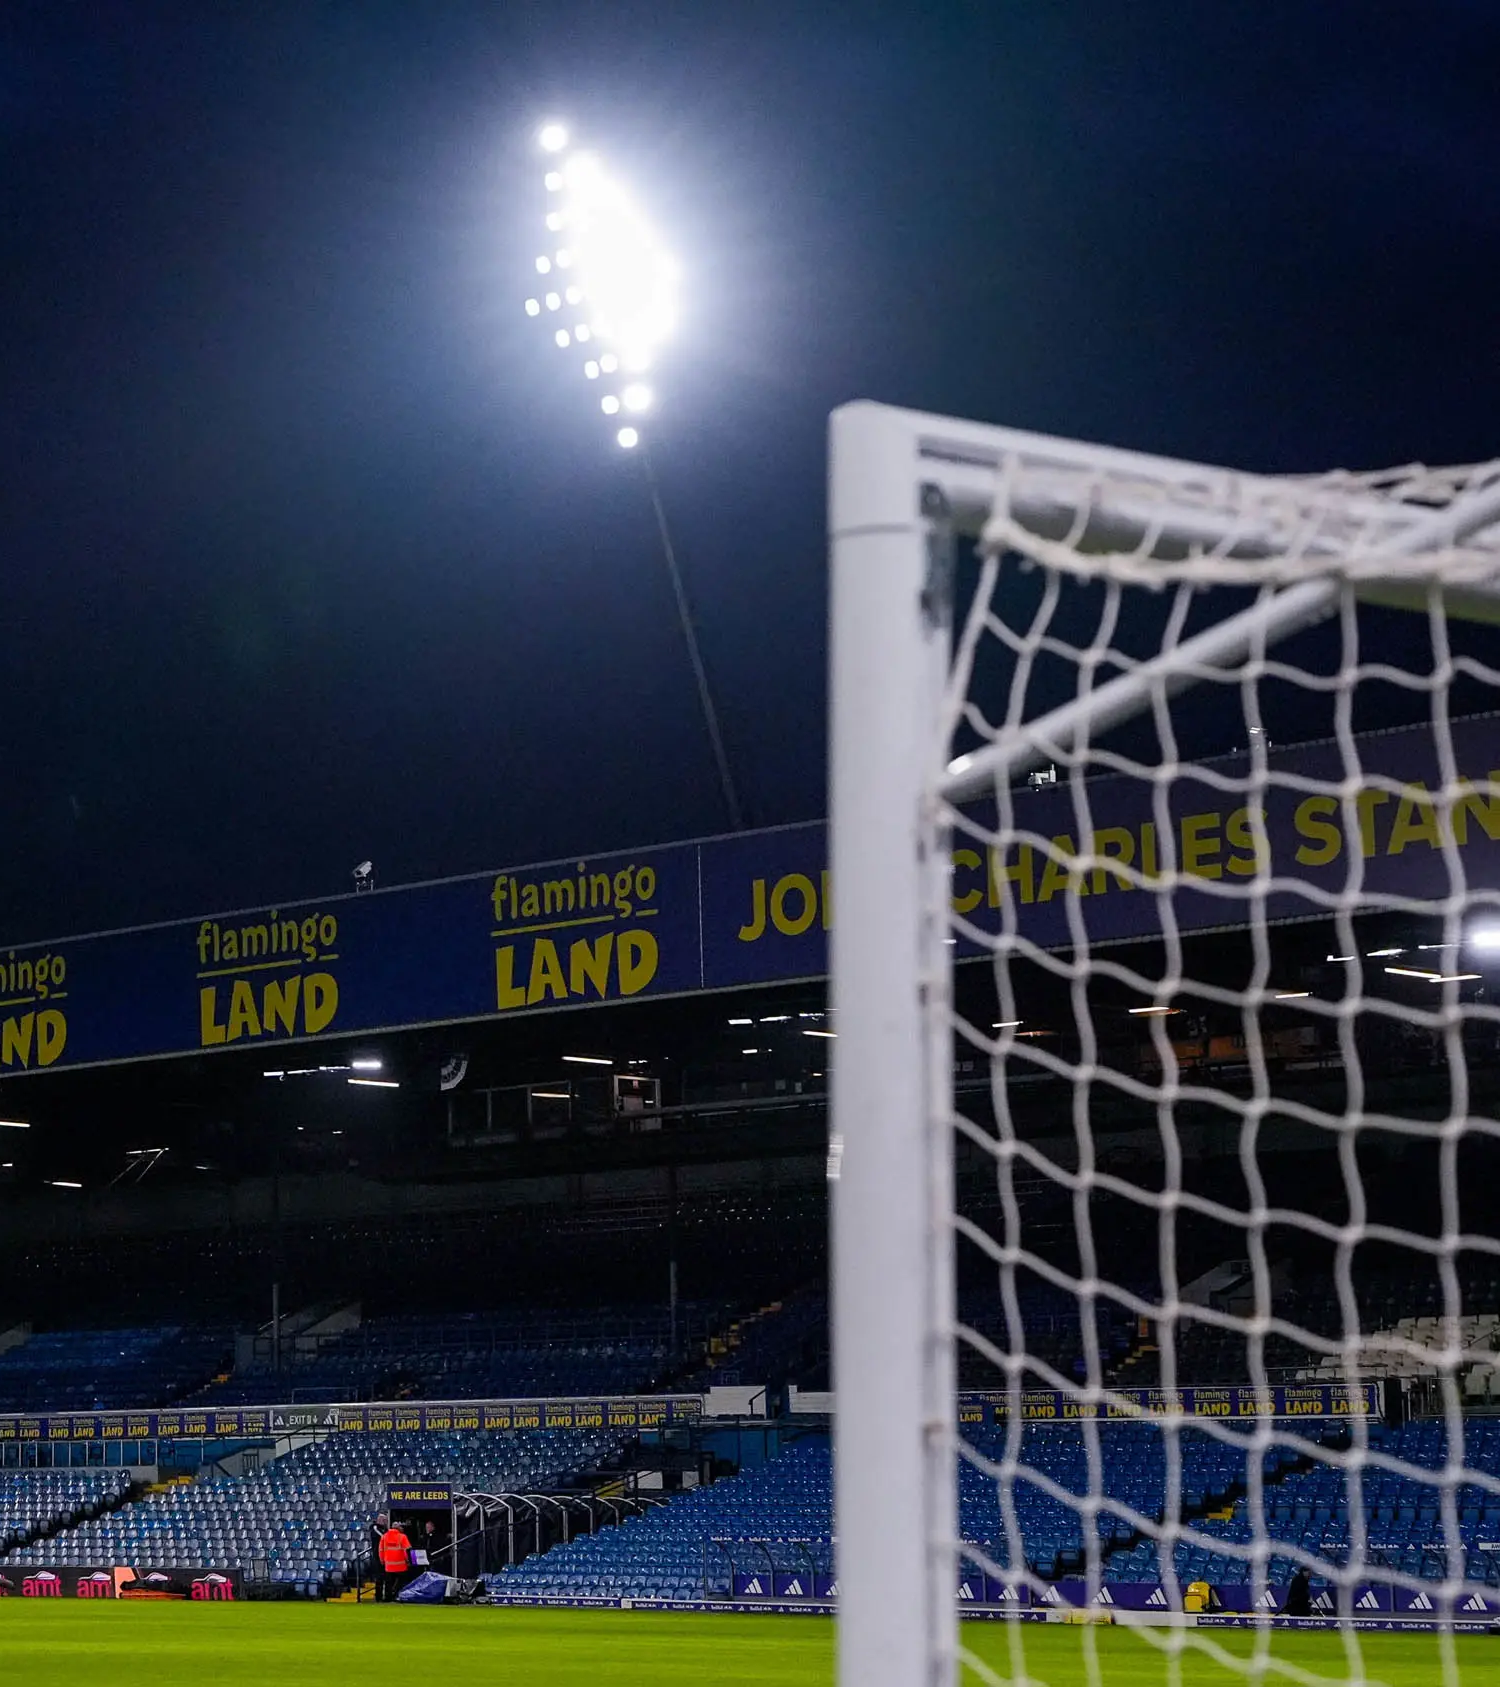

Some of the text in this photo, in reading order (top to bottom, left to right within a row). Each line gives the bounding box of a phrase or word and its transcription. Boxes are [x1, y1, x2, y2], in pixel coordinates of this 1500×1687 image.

[738, 869, 828, 942] JO
[950, 806, 1268, 913] CHARLES
[490, 862, 655, 922] flamingo
[197, 910, 337, 965] flamingo
[496, 929, 659, 1011] LAND
[200, 972, 339, 1048] LAND
[1194, 1402, 1231, 1415] LAND
[1286, 1401, 1323, 1414] LAND
[290, 1415, 305, 1425] EXIT
[484, 1417, 510, 1428] LAND
[513, 1416, 539, 1428] LAND
[545, 1415, 572, 1427] LAND
[575, 1415, 603, 1426] LAND
[609, 1414, 636, 1425] LAND
[960, 1413, 983, 1422] LAND
[184, 1424, 206, 1434] LAND
[215, 1423, 238, 1433] LAND
[339, 1420, 363, 1431] LAND
[369, 1419, 393, 1430] LAND
[396, 1419, 420, 1430] LAND
[426, 1418, 450, 1429] LAND
[454, 1418, 478, 1429] LAND
[20, 1428, 40, 1438] LAND
[49, 1428, 69, 1438] LAND
[73, 1427, 94, 1437] LAND
[102, 1426, 123, 1437] LAND
[128, 1425, 149, 1436] LAND
[158, 1425, 180, 1435] LAND
[391, 1491, 448, 1500] WE ARE LEEDS
[22, 1575, 62, 1597] amt
[77, 1580, 112, 1598] am
